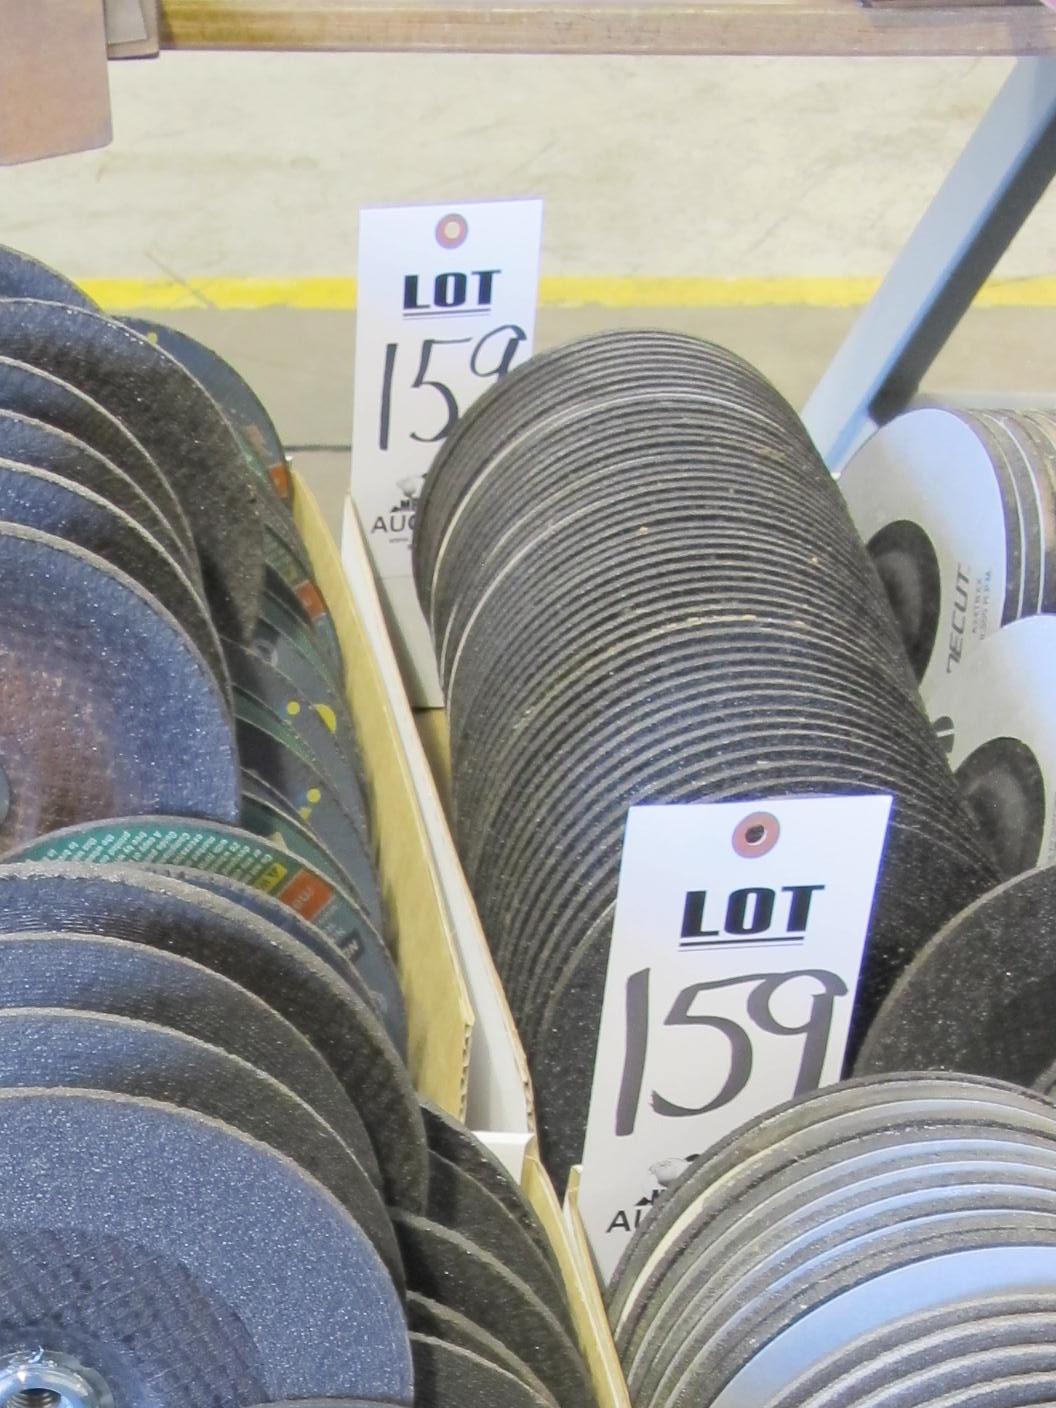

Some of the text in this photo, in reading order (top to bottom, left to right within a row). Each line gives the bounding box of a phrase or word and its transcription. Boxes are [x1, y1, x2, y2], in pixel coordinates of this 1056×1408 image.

[402, 269, 502, 309] LOT
[379, 324, 527, 450] 159
[680, 885, 825, 938] LOT
[615, 968, 848, 1137] 159
